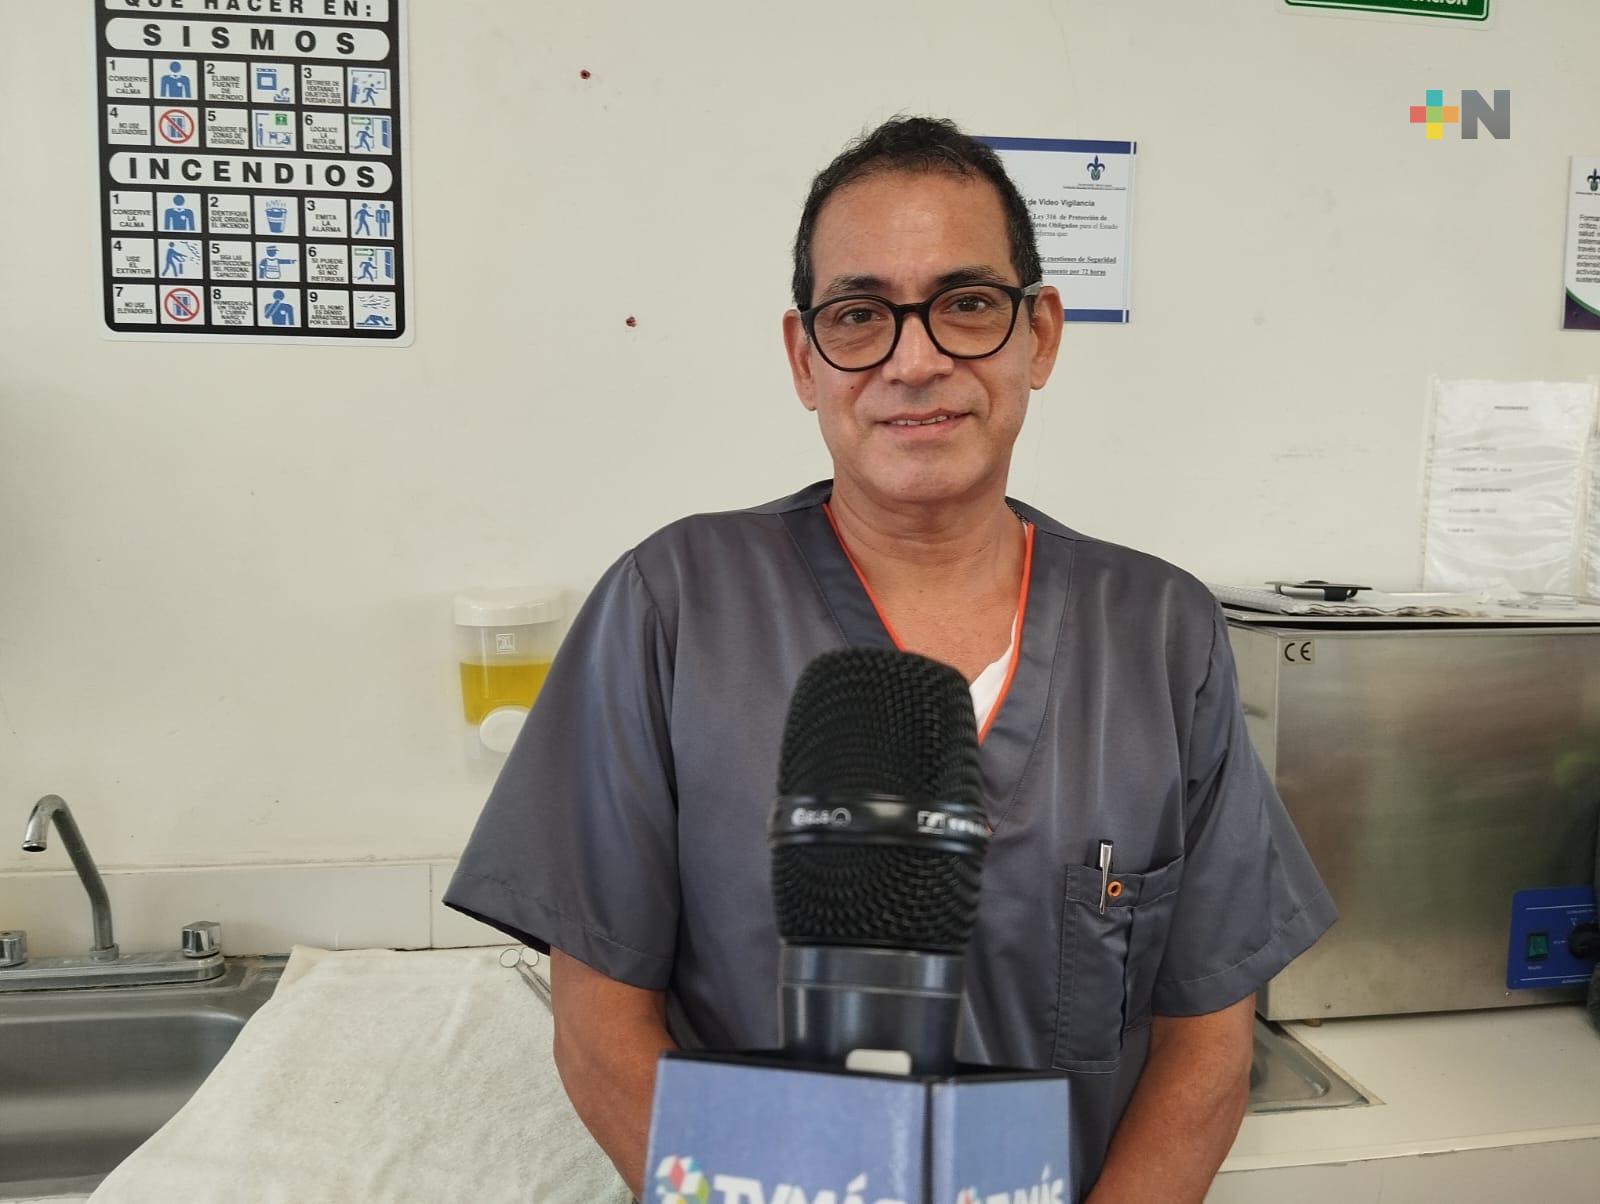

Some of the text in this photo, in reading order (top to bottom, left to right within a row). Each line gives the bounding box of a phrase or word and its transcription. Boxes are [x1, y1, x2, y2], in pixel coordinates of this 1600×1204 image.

[324, 0, 371, 17] EN:
[143, 24, 355, 54] SISMOS
[109, 60, 116, 70] 1
[206, 63, 215, 74] 2
[304, 68, 312, 78] 3
[110, 108, 118, 118] 4
[207, 111, 216, 121] 5
[305, 115, 313, 125] 6
[129, 158, 375, 188] INCENDIOS
[112, 194, 119, 204] 1
[210, 197, 219, 207] 2
[307, 200, 315, 211] 3
[114, 241, 122, 251] 4
[211, 244, 220, 254] 5
[308, 247, 317, 257] 6
[115, 287, 123, 297] 7
[213, 289, 221, 299] 8
[310, 292, 318, 302] 9
[1285, 641, 1311, 662] CE
